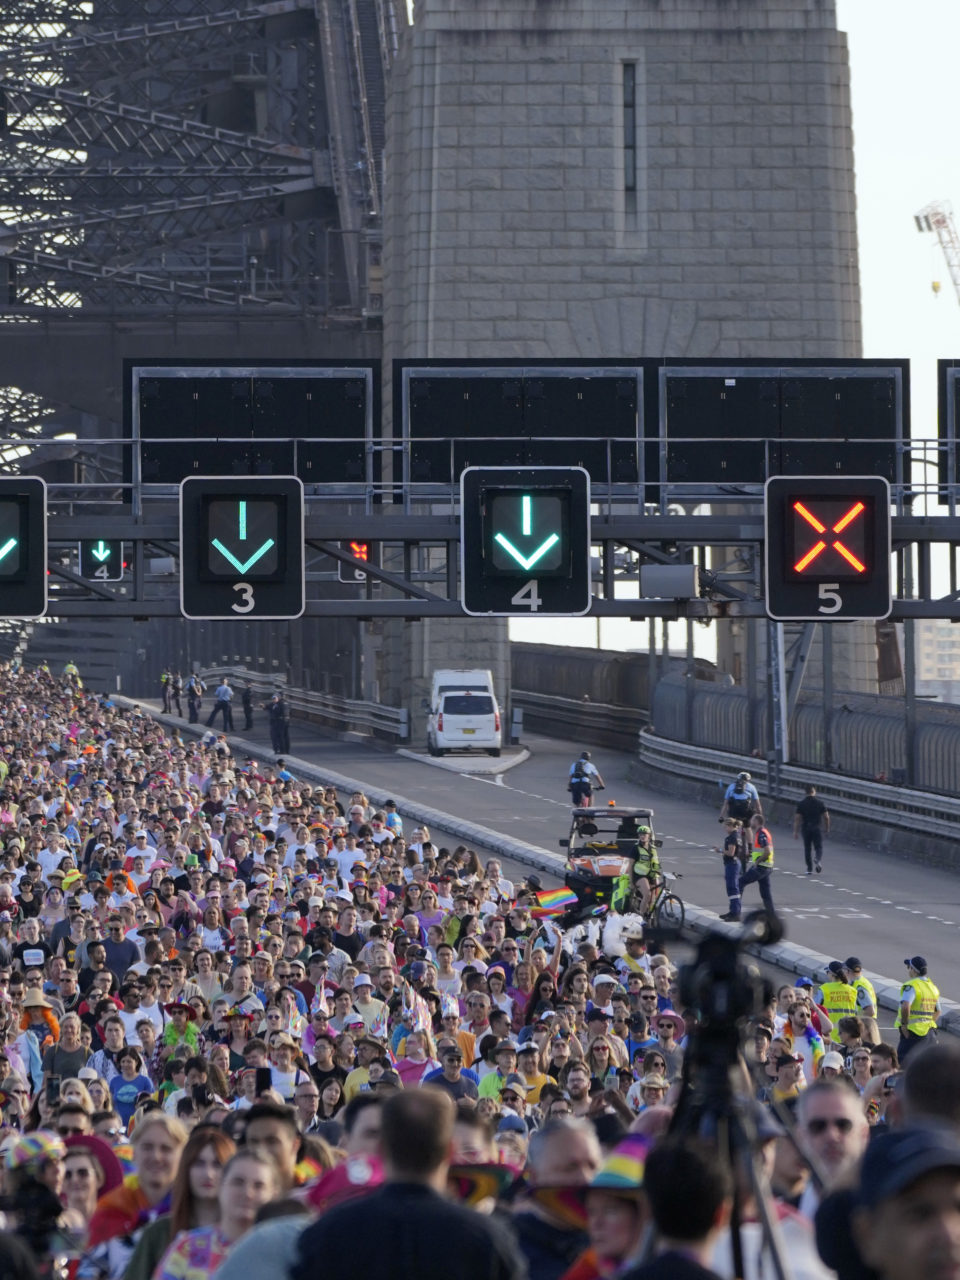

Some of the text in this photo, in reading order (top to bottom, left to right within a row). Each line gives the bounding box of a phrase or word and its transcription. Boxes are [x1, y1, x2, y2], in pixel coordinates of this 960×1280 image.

[94, 564, 109, 579] 4
[231, 583, 255, 614] 3
[511, 580, 542, 611] 4
[818, 583, 843, 614] 5
